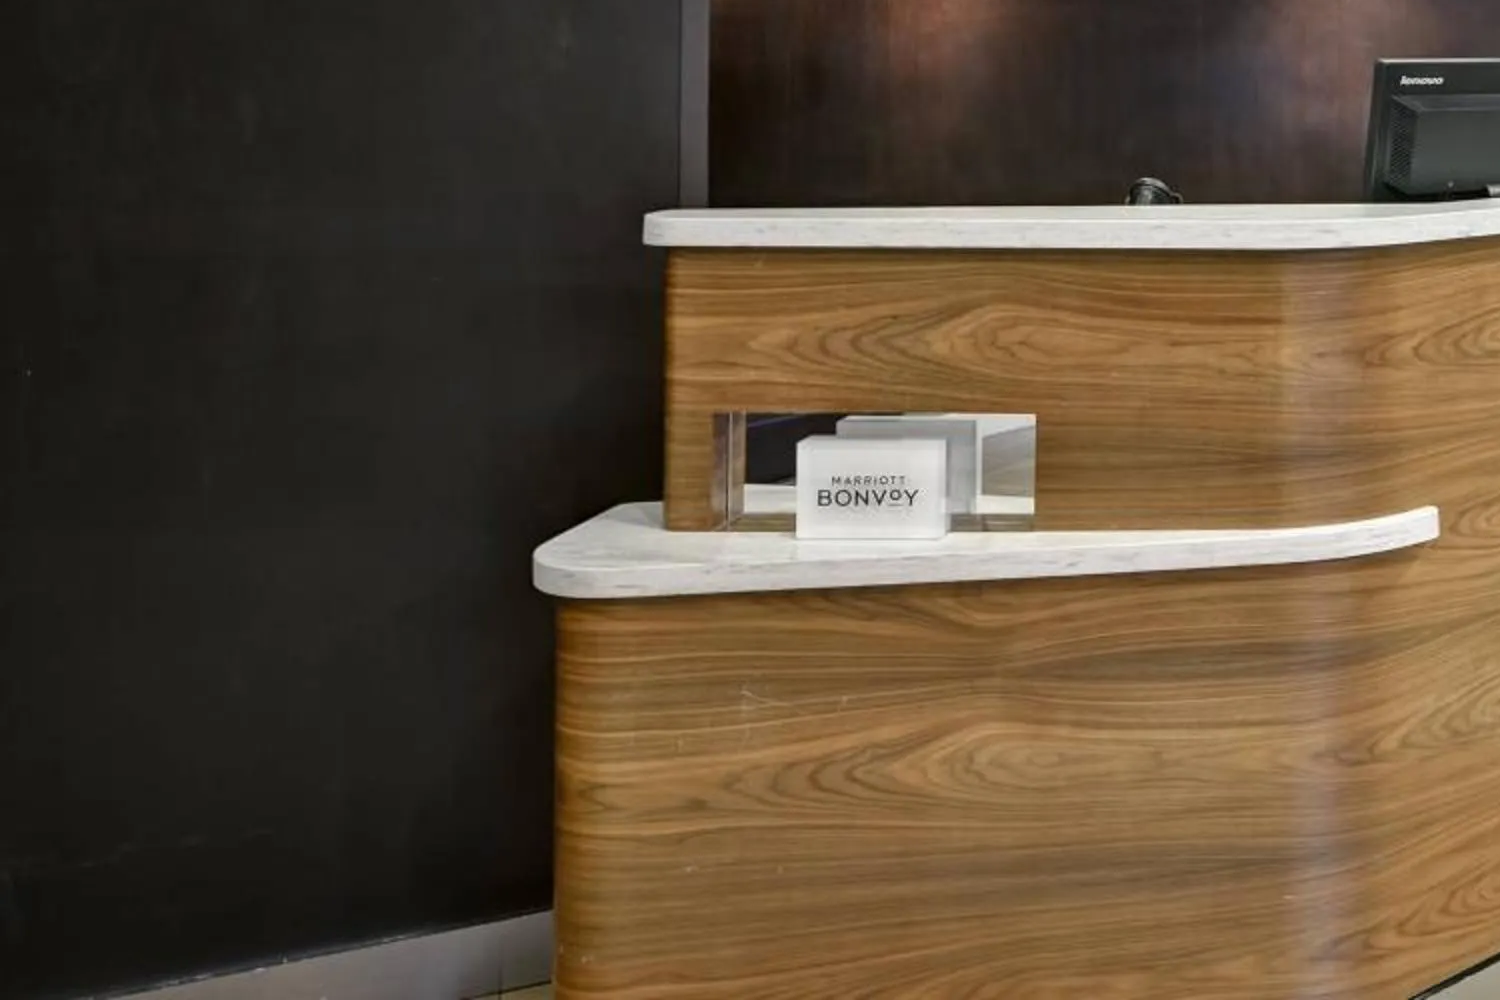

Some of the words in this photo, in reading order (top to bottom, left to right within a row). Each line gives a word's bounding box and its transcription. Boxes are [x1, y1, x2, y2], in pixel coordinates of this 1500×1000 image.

[1400, 74, 1445, 87] lenovo
[831, 475, 906, 487] MARRIOTT
[816, 488, 919, 507] BONVOY
